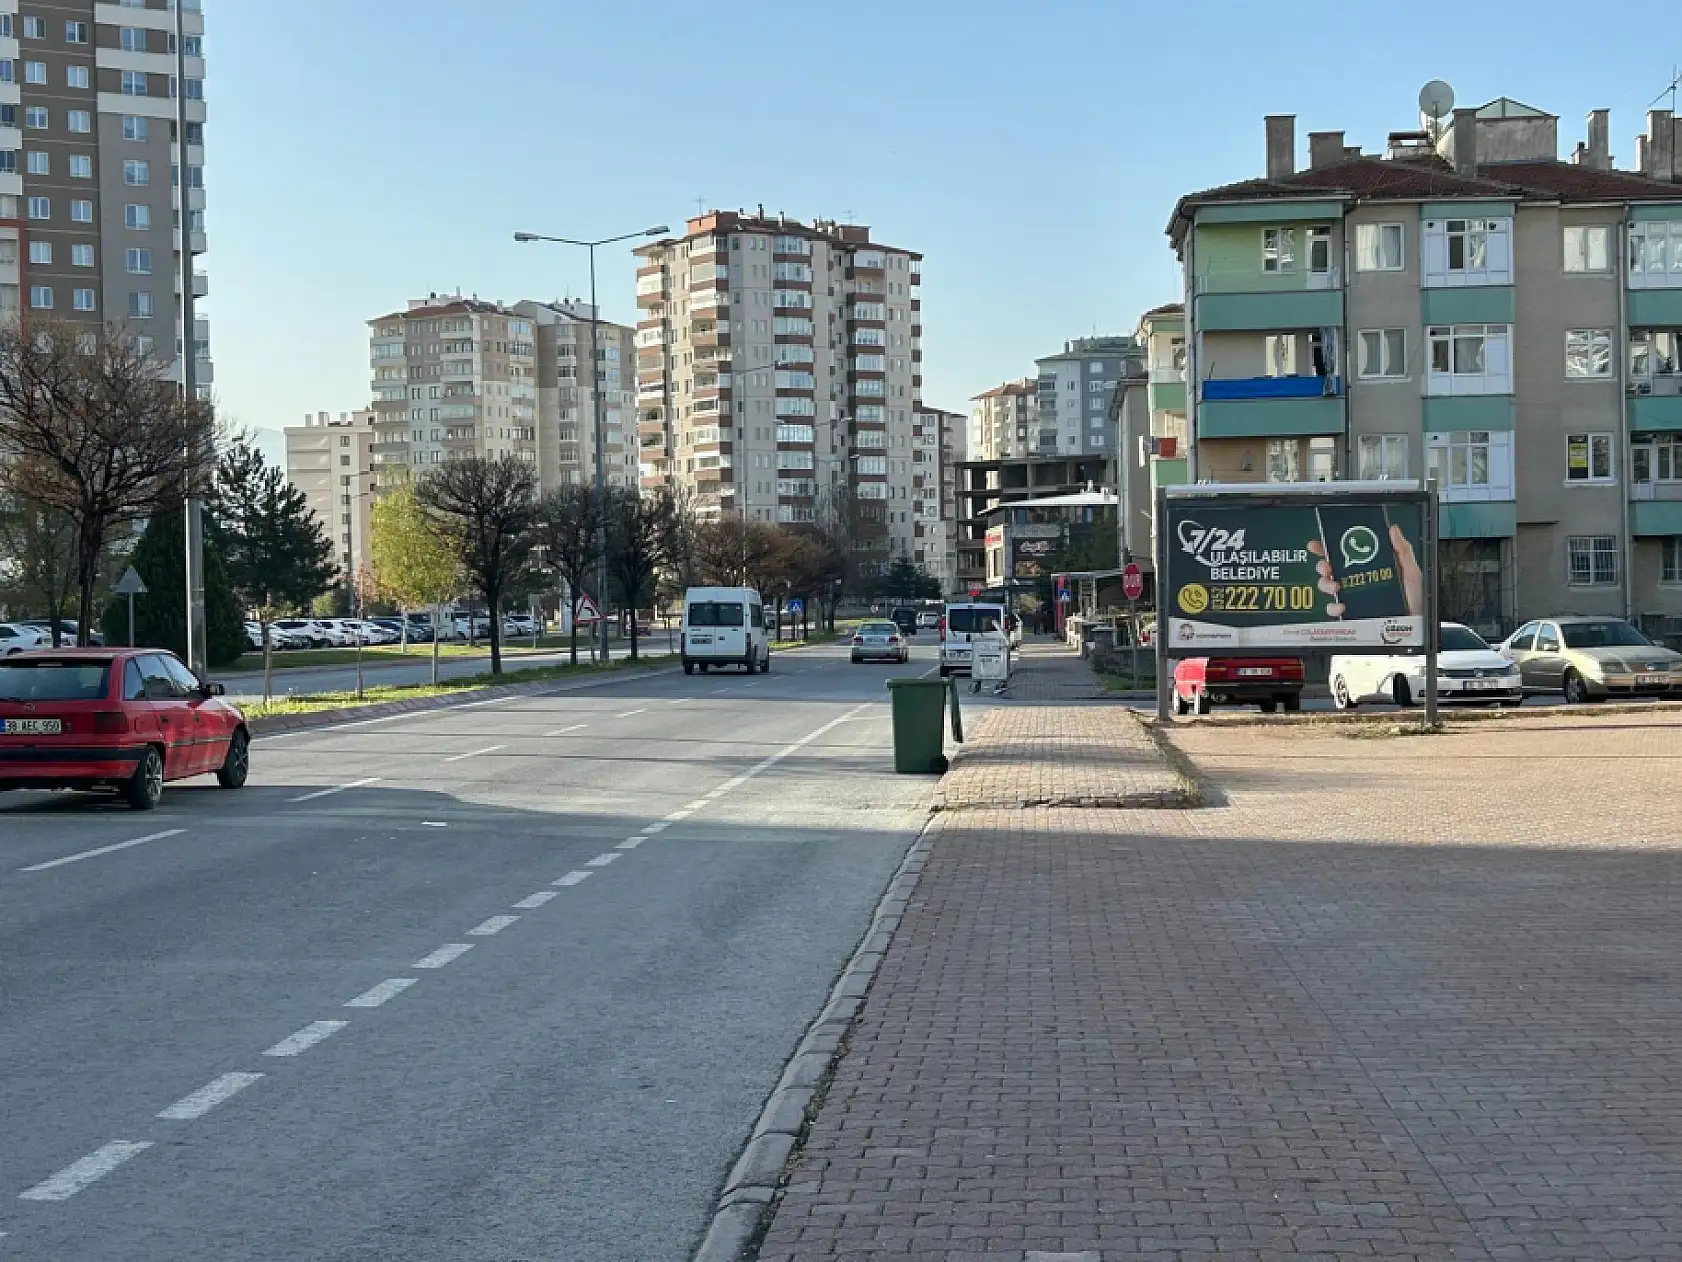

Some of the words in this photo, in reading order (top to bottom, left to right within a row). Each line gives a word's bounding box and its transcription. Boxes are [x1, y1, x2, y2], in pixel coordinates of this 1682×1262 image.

[1190, 527, 1246, 553] 7/24
[1210, 566, 1280, 580] BELEDİYE
[1225, 586, 1260, 610] 222
[1263, 586, 1286, 610] 70
[1290, 586, 1314, 610] 00
